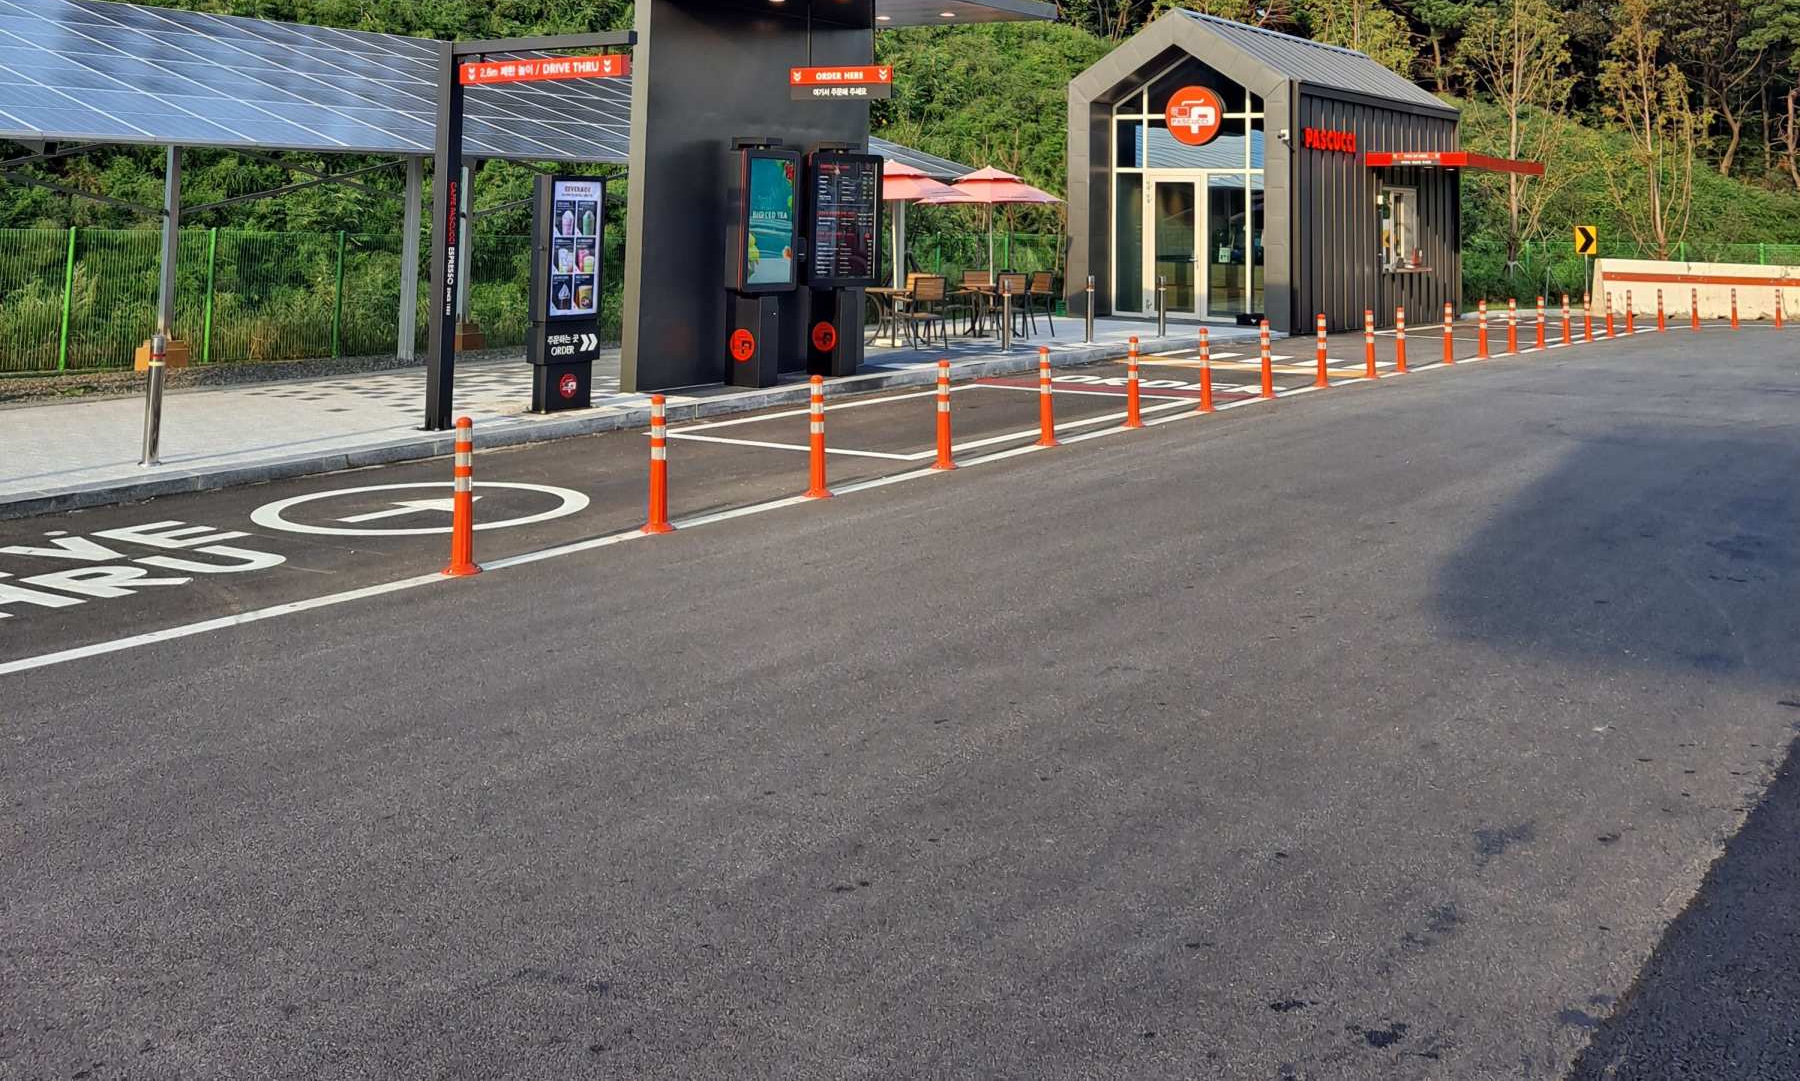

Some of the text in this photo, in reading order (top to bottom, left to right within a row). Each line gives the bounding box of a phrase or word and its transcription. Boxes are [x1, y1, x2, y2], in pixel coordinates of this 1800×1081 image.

[542, 62, 571, 75] DRIVE
[573, 60, 600, 73] THRU
[815, 71, 864, 80] ORDER HERE
[812, 87, 830, 96] 여기서
[849, 87, 868, 96] 주세요
[1304, 127, 1356, 153] PASCUCCI
[447, 246, 455, 285] ESPRESSO
[547, 333, 580, 345] 주문하는 곳
[550, 345, 575, 356] ORDER
